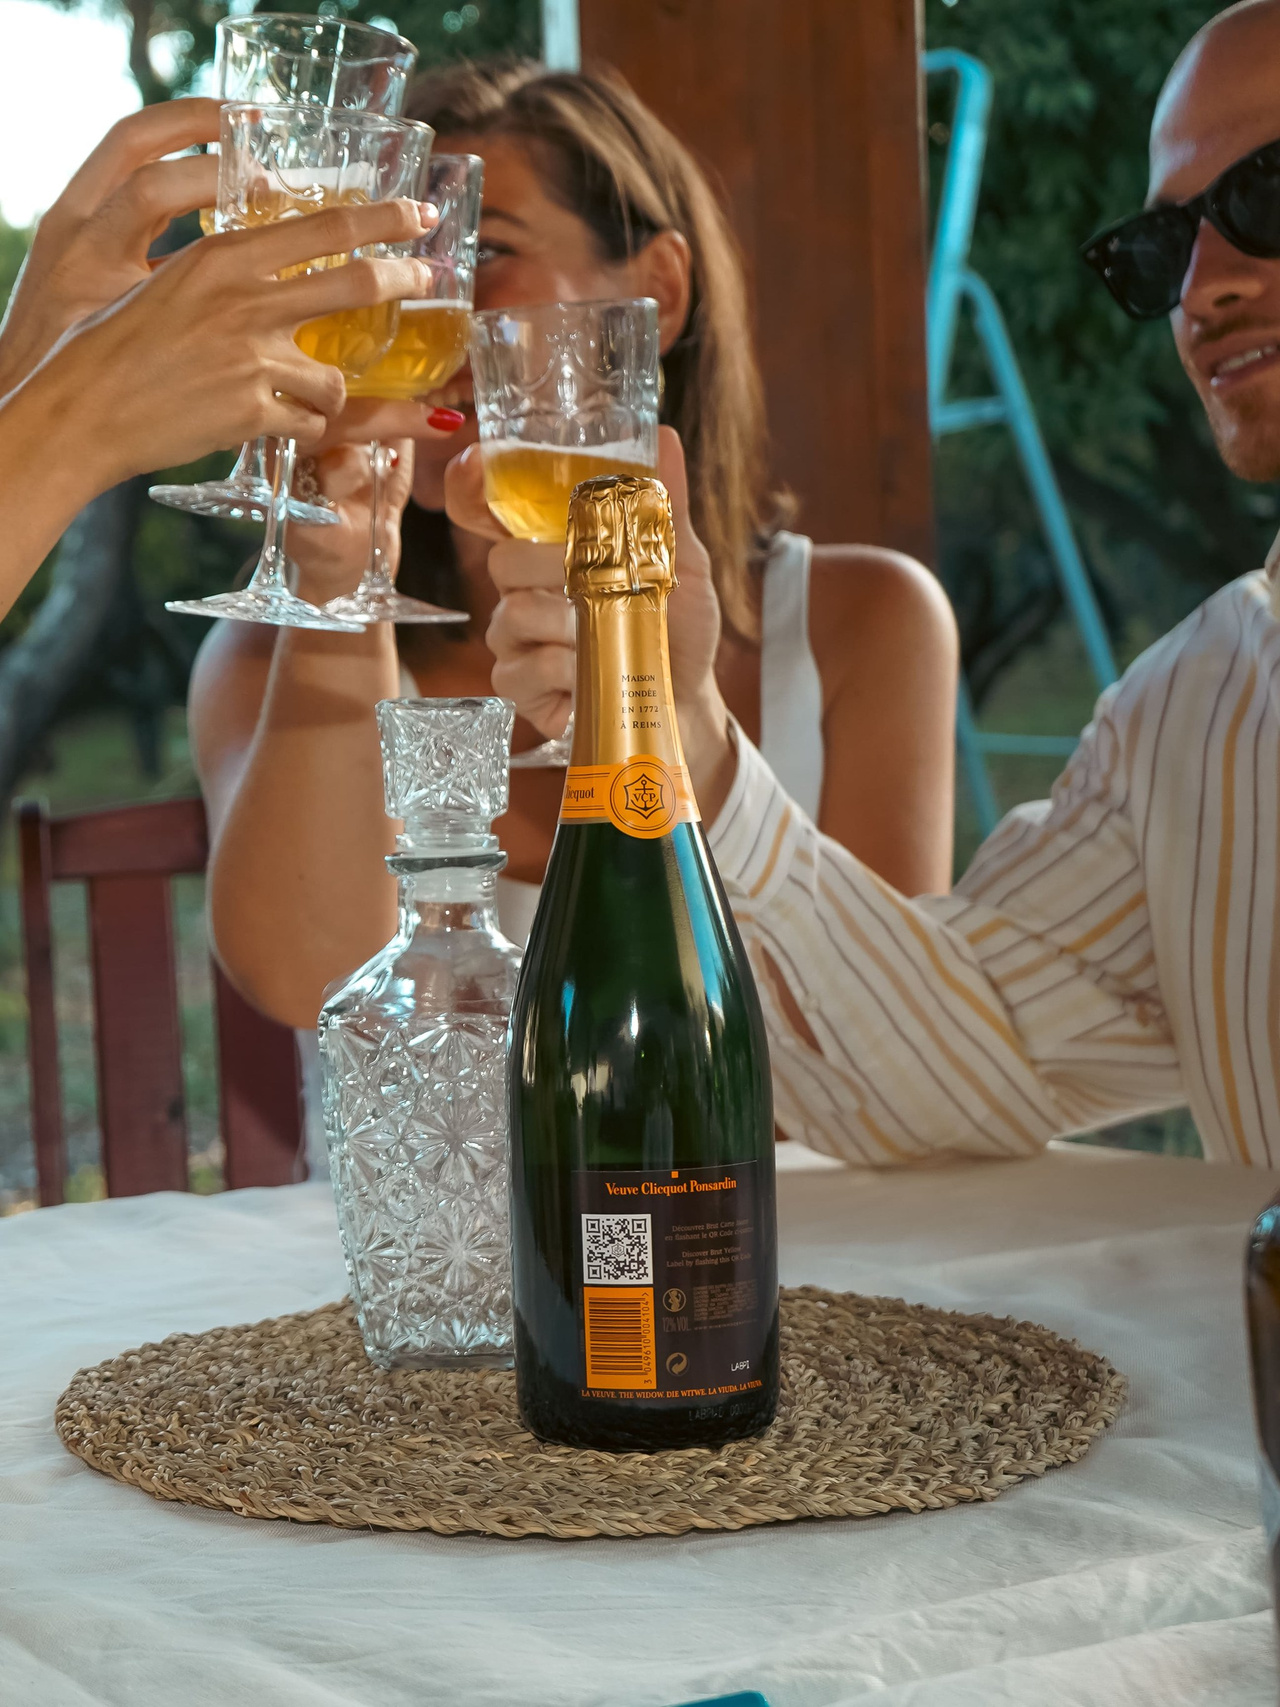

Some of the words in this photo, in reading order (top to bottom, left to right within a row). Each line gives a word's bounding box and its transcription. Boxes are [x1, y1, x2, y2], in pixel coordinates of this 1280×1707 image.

[622, 674, 656, 682] MAISON
[622, 688, 657, 698] FONDÉE
[639, 705, 659, 713] 1772
[632, 720, 662, 729] REIMS
[633, 793, 656, 803] VCP
[605, 1182, 639, 1195] Veuve
[641, 1182, 688, 1197] Clicquot
[689, 1177, 737, 1193] Ponsardin
[672, 1223, 705, 1232] Découvrez
[674, 1233, 700, 1241] flashant
[681, 1250, 709, 1258] Discover
[686, 1260, 694, 1268] by
[695, 1257, 719, 1266] flashing
[641, 1301, 651, 1335] 004104
[642, 1339, 652, 1373] 049610
[581, 1389, 591, 1397] LA
[618, 1391, 635, 1399] THE
[666, 1390, 680, 1398] DIE
[739, 1383, 748, 1391] LA
